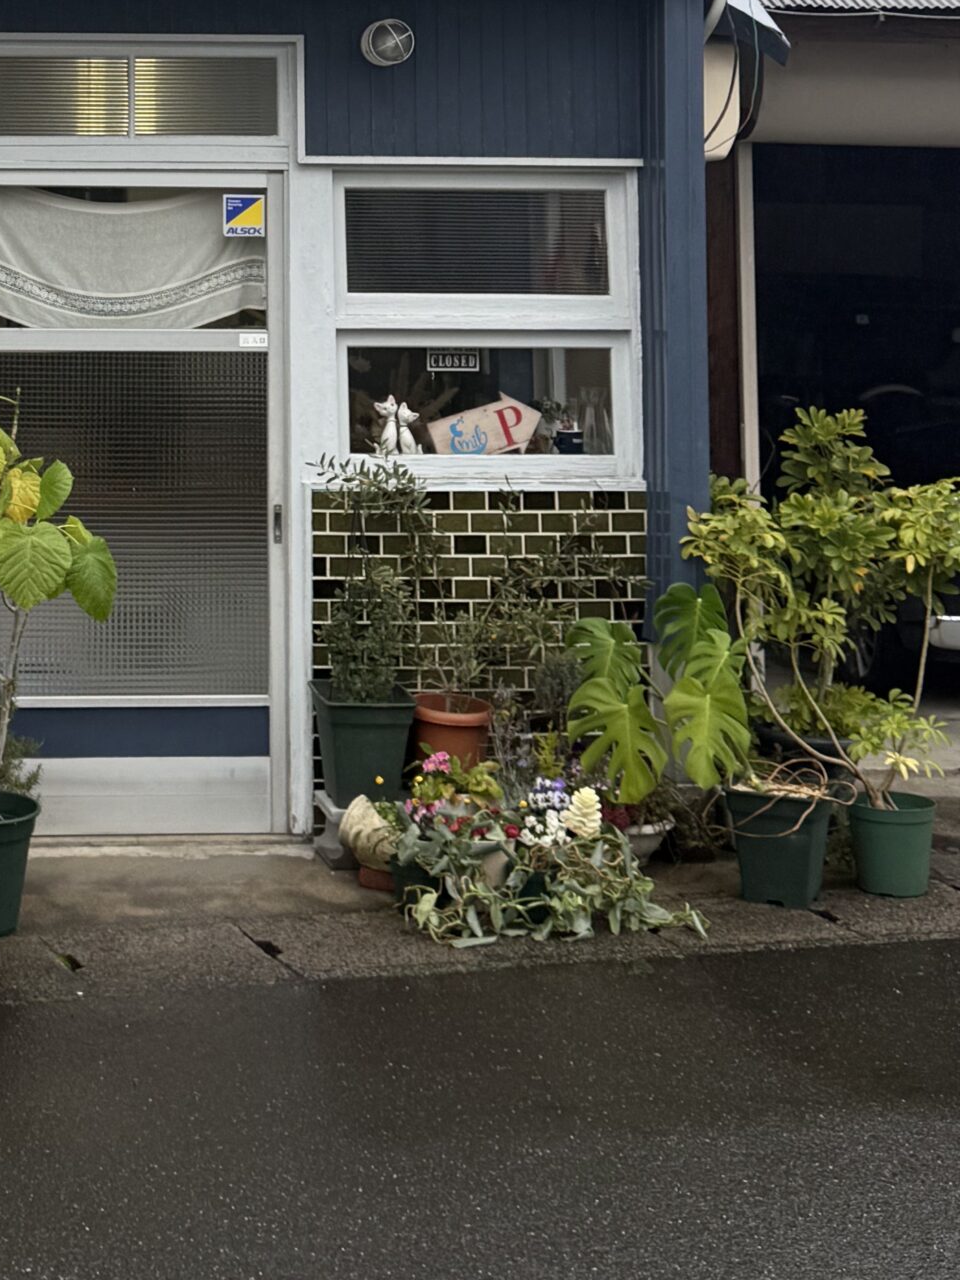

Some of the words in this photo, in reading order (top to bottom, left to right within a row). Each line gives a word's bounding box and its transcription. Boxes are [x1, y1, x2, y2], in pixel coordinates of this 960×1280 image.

[225, 226, 263, 235] ALSOK
[430, 354, 476, 367] CLOSED
[493, 405, 524, 448] P
